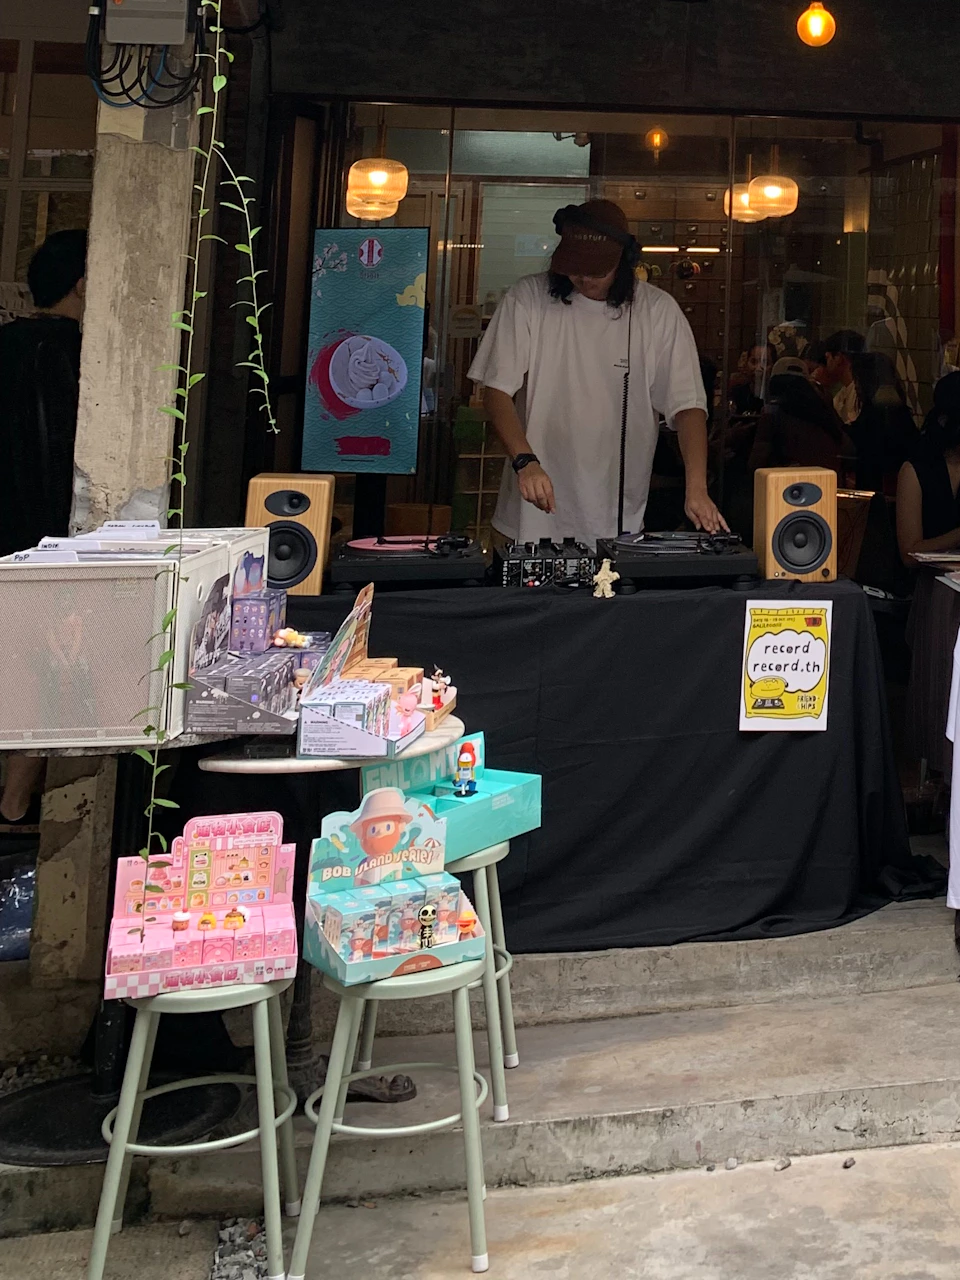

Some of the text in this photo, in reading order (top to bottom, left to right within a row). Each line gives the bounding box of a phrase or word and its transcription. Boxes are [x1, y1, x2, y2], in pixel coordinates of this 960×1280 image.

[764, 640, 811, 654] record
[753, 659, 820, 672] record.th
[322, 866, 352, 882] BOB
[354, 852, 394, 876] ISLAND
